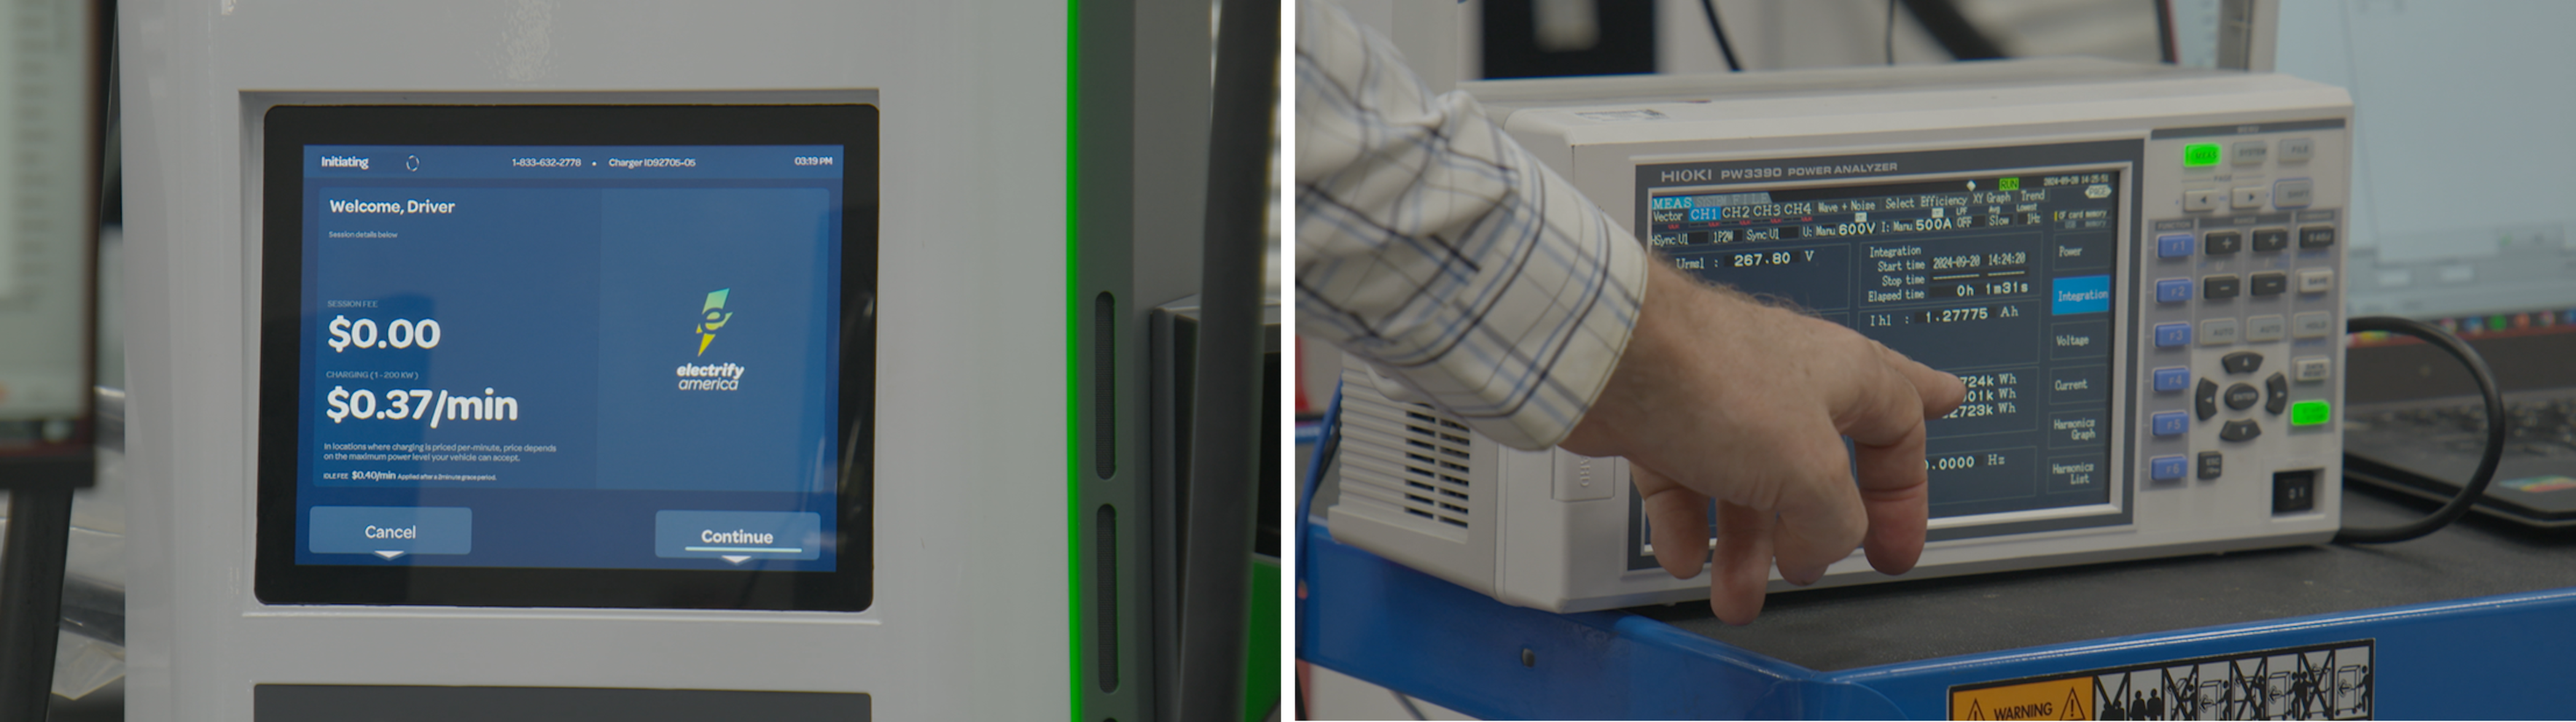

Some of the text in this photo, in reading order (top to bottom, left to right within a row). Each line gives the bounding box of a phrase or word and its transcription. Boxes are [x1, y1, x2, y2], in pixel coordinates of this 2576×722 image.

[321, 156, 369, 170] Initiating
[512, 158, 582, 167] 1-833-632-2778
[609, 158, 696, 169] Charger ID92705-05
[794, 156, 833, 166] 03:19 PM
[1661, 162, 1898, 182] HIOKI PW3390 POWER ANALYZER
[2000, 179, 2018, 190] RUN
[1652, 192, 1770, 209] MEAS SYSTEM FILE
[1972, 191, 2011, 204] XY Graph
[2020, 188, 2045, 201] Trend
[329, 198, 456, 215] Welcome, Driver
[1886, 194, 1967, 209] Select Efficiency
[1652, 199, 1876, 222] Vector CH1 CH2 CH3 CH4 Wave + Noise
[1988, 205, 2001, 215] Avg
[2069, 211, 2084, 219] card
[1916, 217, 1952, 231] 500A
[1956, 216, 1972, 228] OFF
[1988, 214, 2010, 226] Slow
[329, 230, 398, 238] Session details below
[1746, 228, 1768, 241] Sync
[1838, 222, 1876, 236] 600V
[1870, 246, 1921, 259] Integration
[2058, 245, 2083, 258] Power
[1734, 252, 1791, 267] 267.80
[1805, 250, 1814, 262] V
[1878, 252, 2026, 272] Start time 2024-09-20 14:24:20
[1882, 275, 1925, 287] Stop time
[1868, 290, 1902, 303] Elapsed
[1905, 289, 1925, 299] time
[2058, 290, 2108, 303] Integration
[327, 300, 378, 308] SESSION FEE
[1926, 307, 1988, 323] 1.27775
[2000, 306, 2018, 318] Ah
[327, 314, 441, 353] $0.00
[2056, 335, 2089, 348] Voltage
[326, 370, 369, 379] CHARGING
[676, 362, 745, 380] electrify
[678, 377, 739, 391] america
[1959, 373, 2017, 388] 724k Wh
[2055, 379, 2088, 392] Current
[1962, 387, 2017, 403] 01k Wh
[327, 385, 518, 429] $0.37/min
[1942, 401, 2017, 419] 2723k Wh
[2053, 418, 2096, 430] Harmonics
[2071, 429, 2096, 441] Graph
[324, 442, 557, 453] In locations where charging is priced per-minute, price depends
[335, 452, 348, 460] the
[348, 452, 386, 461] maximum
[387, 454, 411, 462] power
[412, 453, 430, 461] level
[431, 454, 448, 462] your
[450, 453, 476, 462] vehicle
[493, 454, 520, 463] accept.
[1987, 453, 2005, 466] Hz
[1580, 455, 1591, 487] ARD
[2053, 462, 2094, 475] Harmonics
[351, 470, 396, 481] $0.40/min
[2070, 474, 2090, 485] List
[364, 524, 416, 539] Cancel
[701, 529, 773, 544] Continue
[1994, 702, 2053, 721] WARNING
